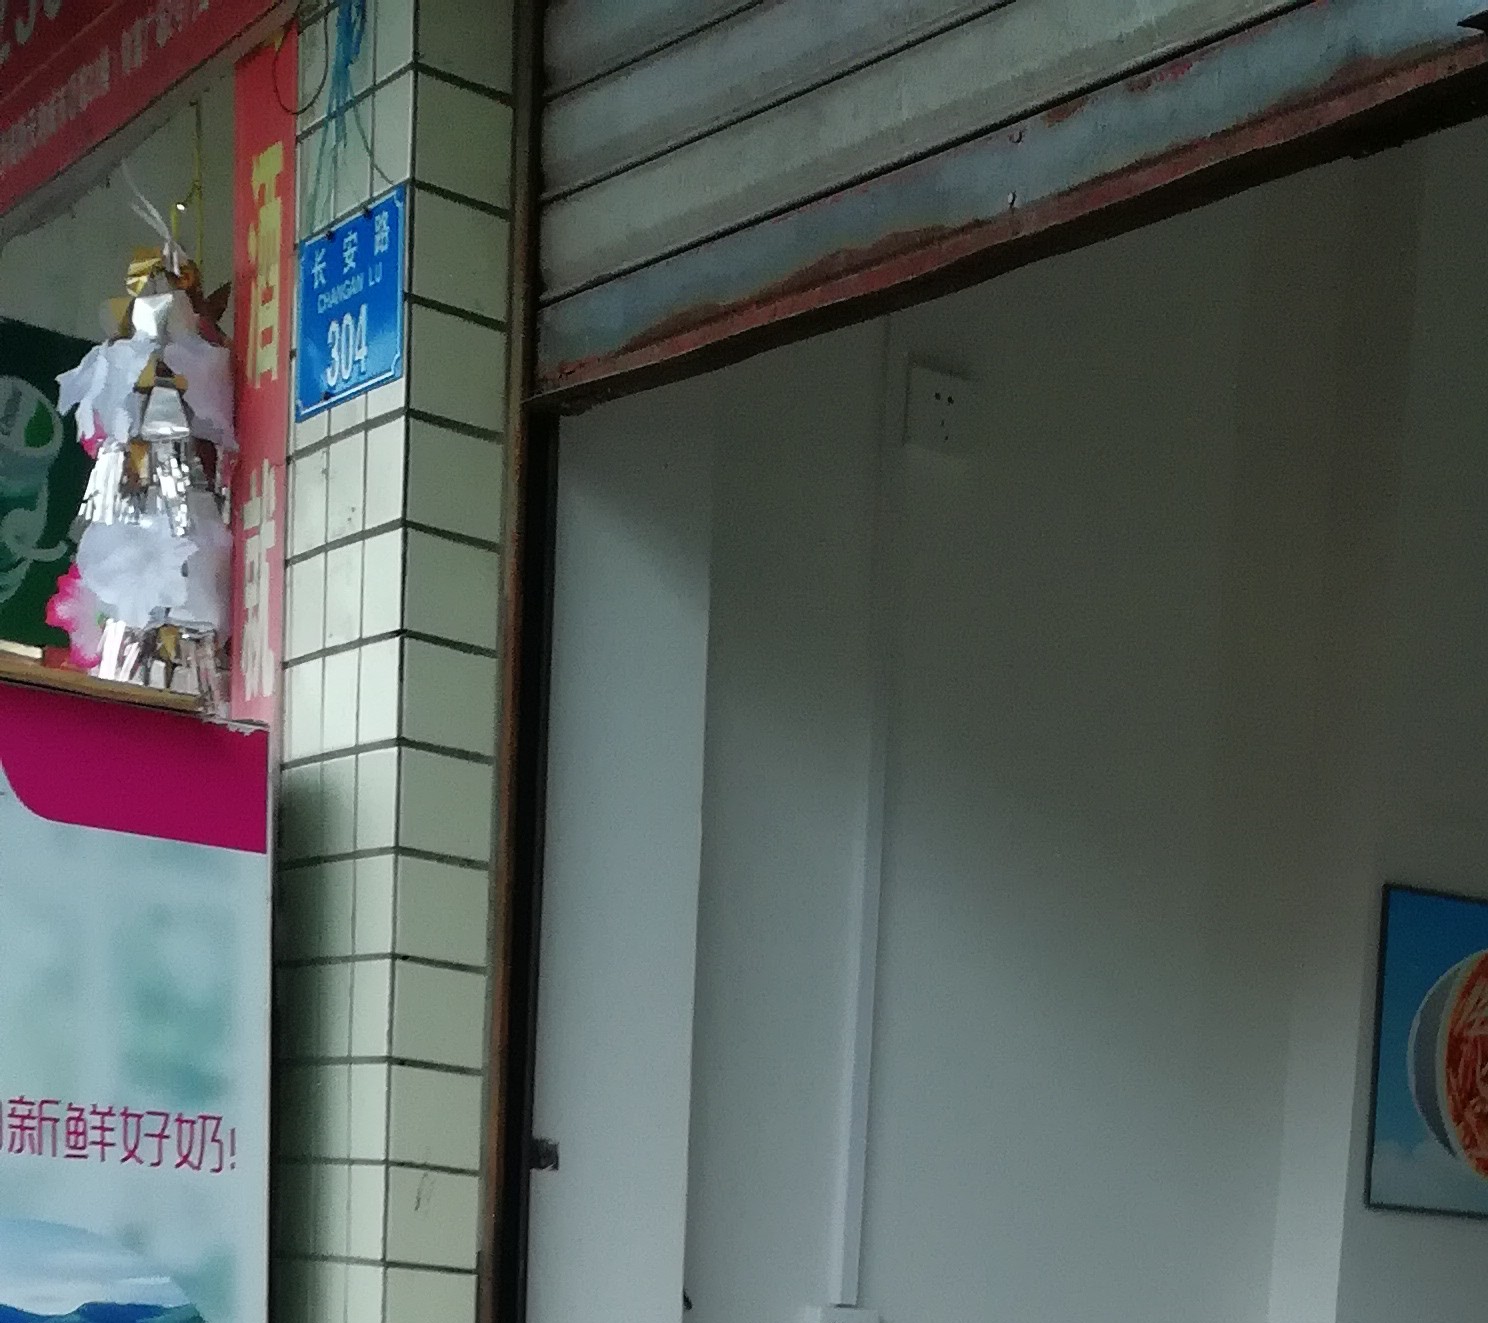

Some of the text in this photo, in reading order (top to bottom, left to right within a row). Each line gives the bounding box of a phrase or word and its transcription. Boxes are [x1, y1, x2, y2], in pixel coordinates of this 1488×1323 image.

[312, 211, 390, 289] 长安路
[368, 261, 383, 287] LU
[327, 303, 368, 387] 304
[0, 1095, 236, 1173] 新鲜好奶!
